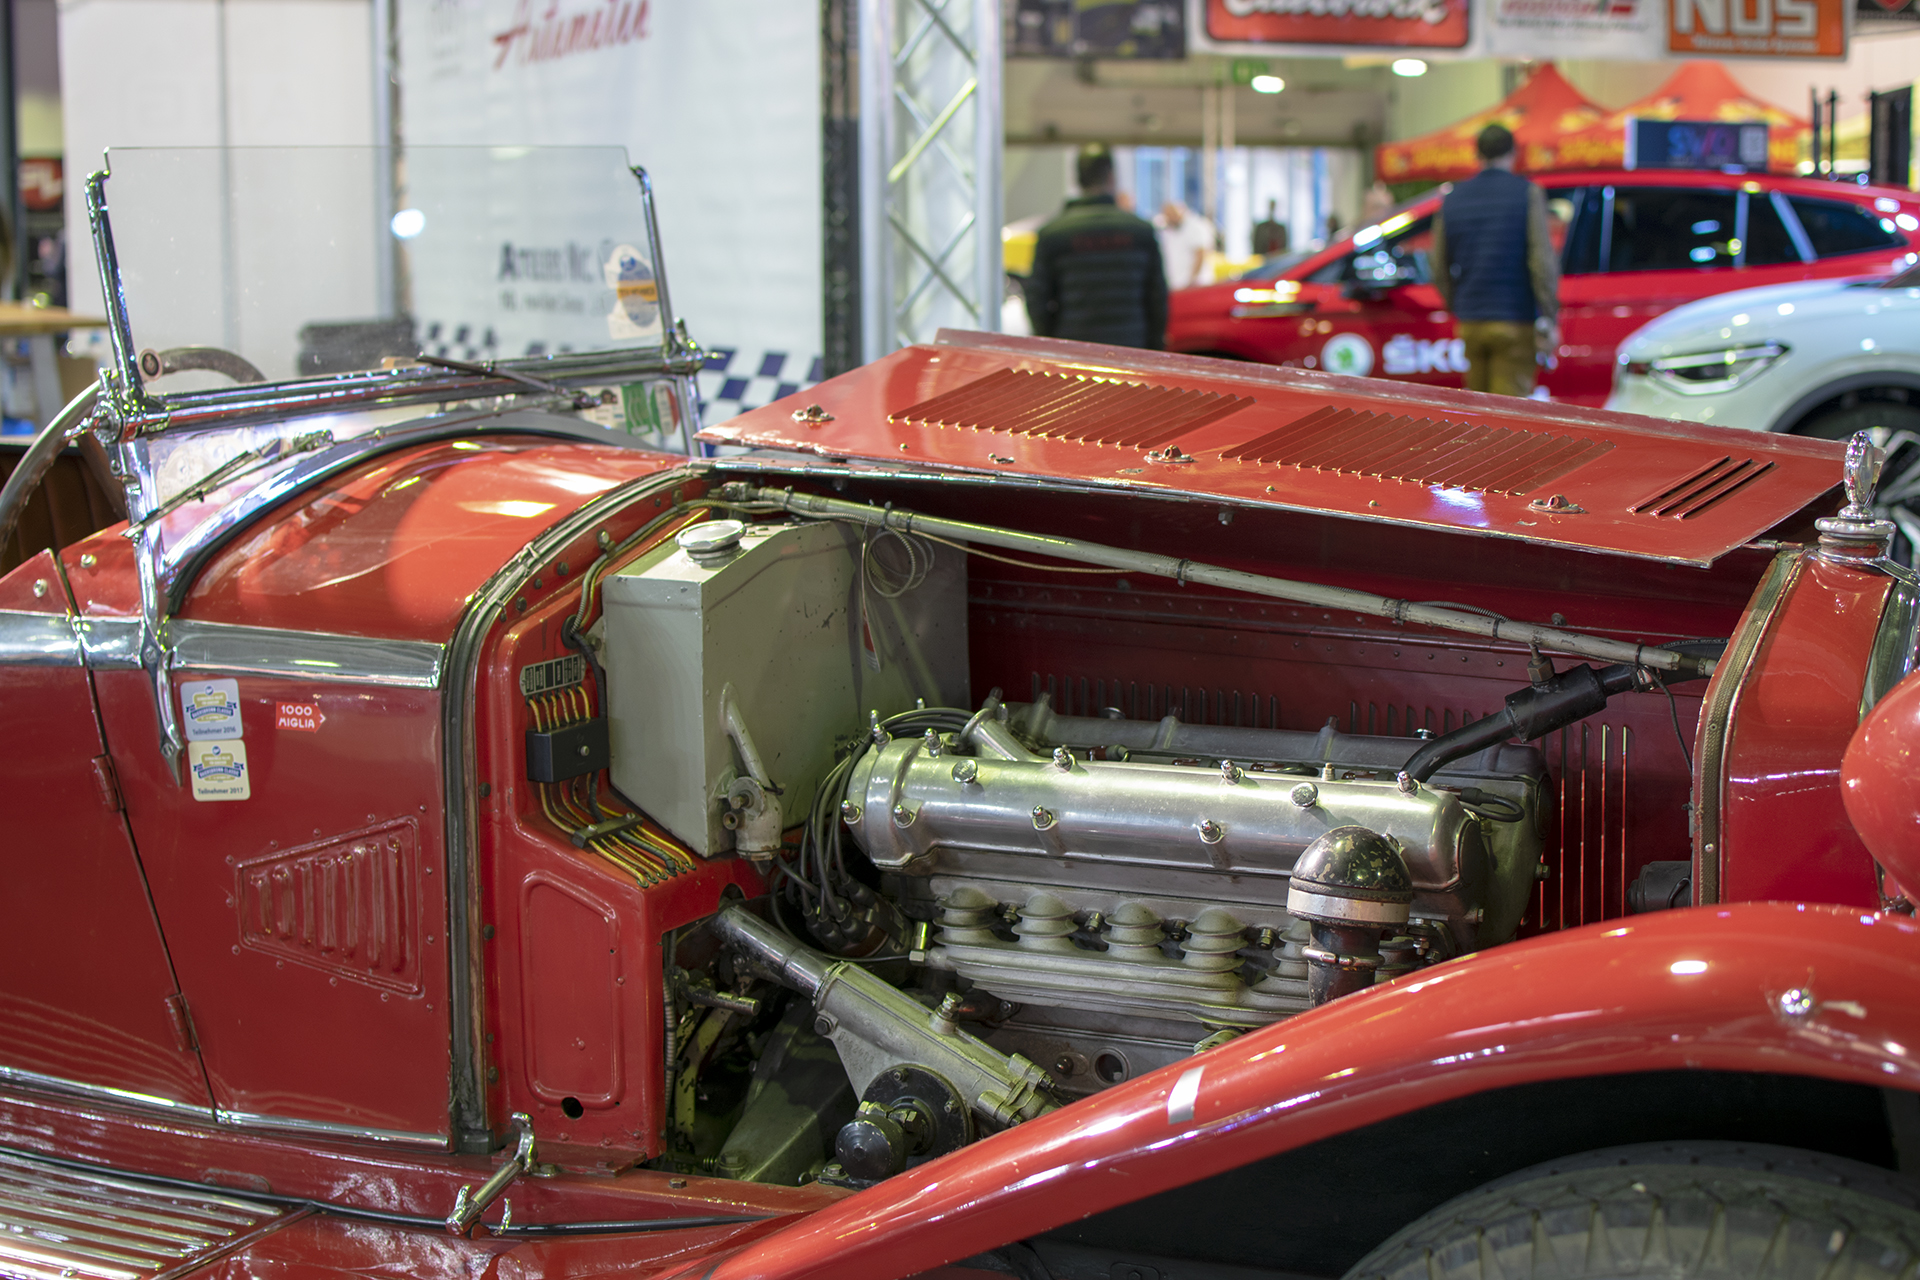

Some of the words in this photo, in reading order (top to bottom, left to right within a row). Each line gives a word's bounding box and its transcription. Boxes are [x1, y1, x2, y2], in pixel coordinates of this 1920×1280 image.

[280, 705, 313, 716] 1000
[278, 717, 316, 729] MIGLIA
[192, 727, 222, 736] Teilnehmer
[197, 787, 228, 795] Teilnehmer
[229, 786, 243, 794] 2017
